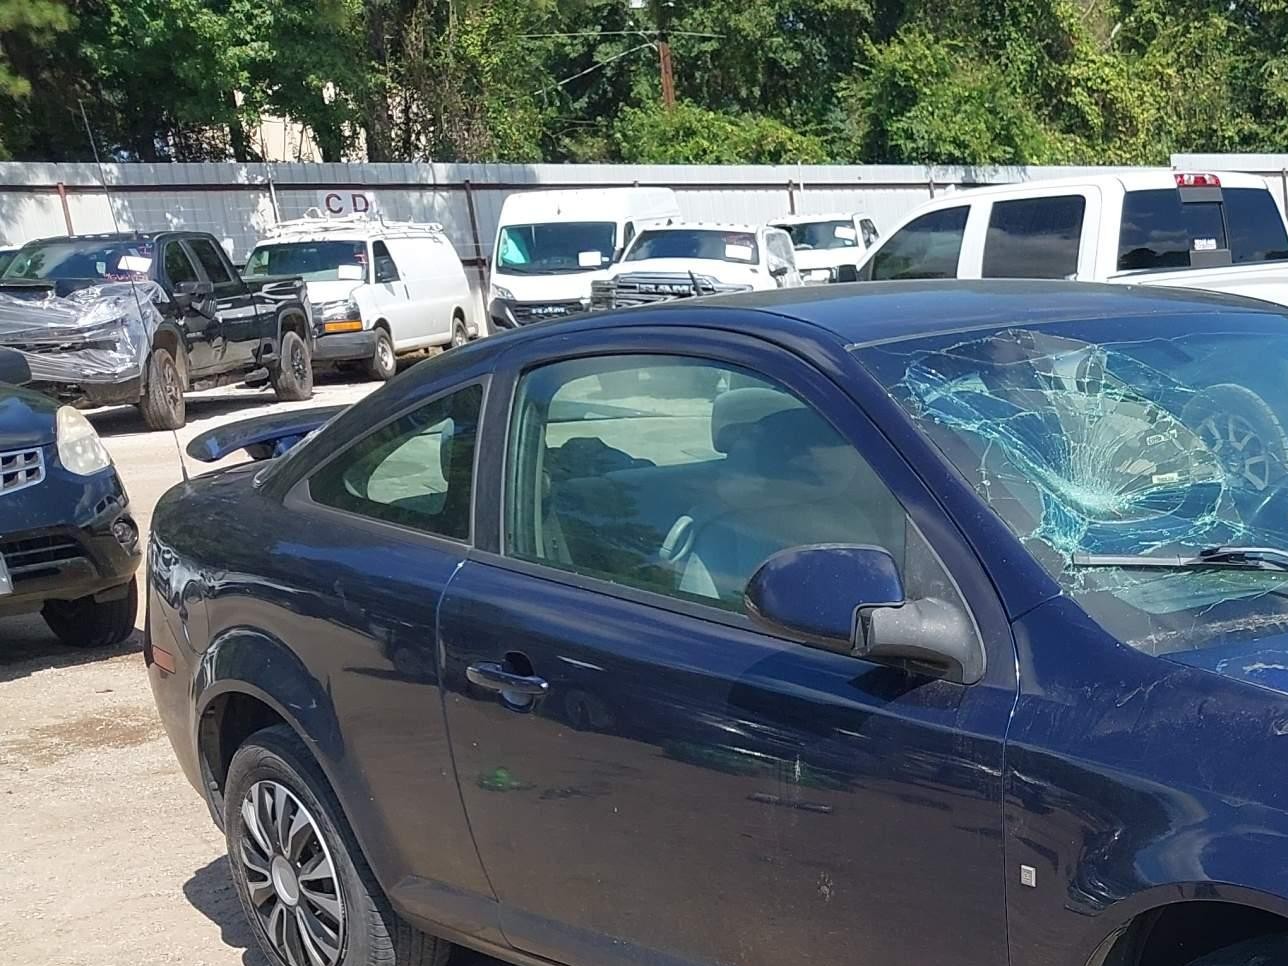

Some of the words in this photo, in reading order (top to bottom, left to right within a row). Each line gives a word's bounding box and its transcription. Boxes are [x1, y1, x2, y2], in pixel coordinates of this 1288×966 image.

[325, 193, 343, 214] C
[352, 193, 369, 213] D
[639, 284, 690, 293] RAM
